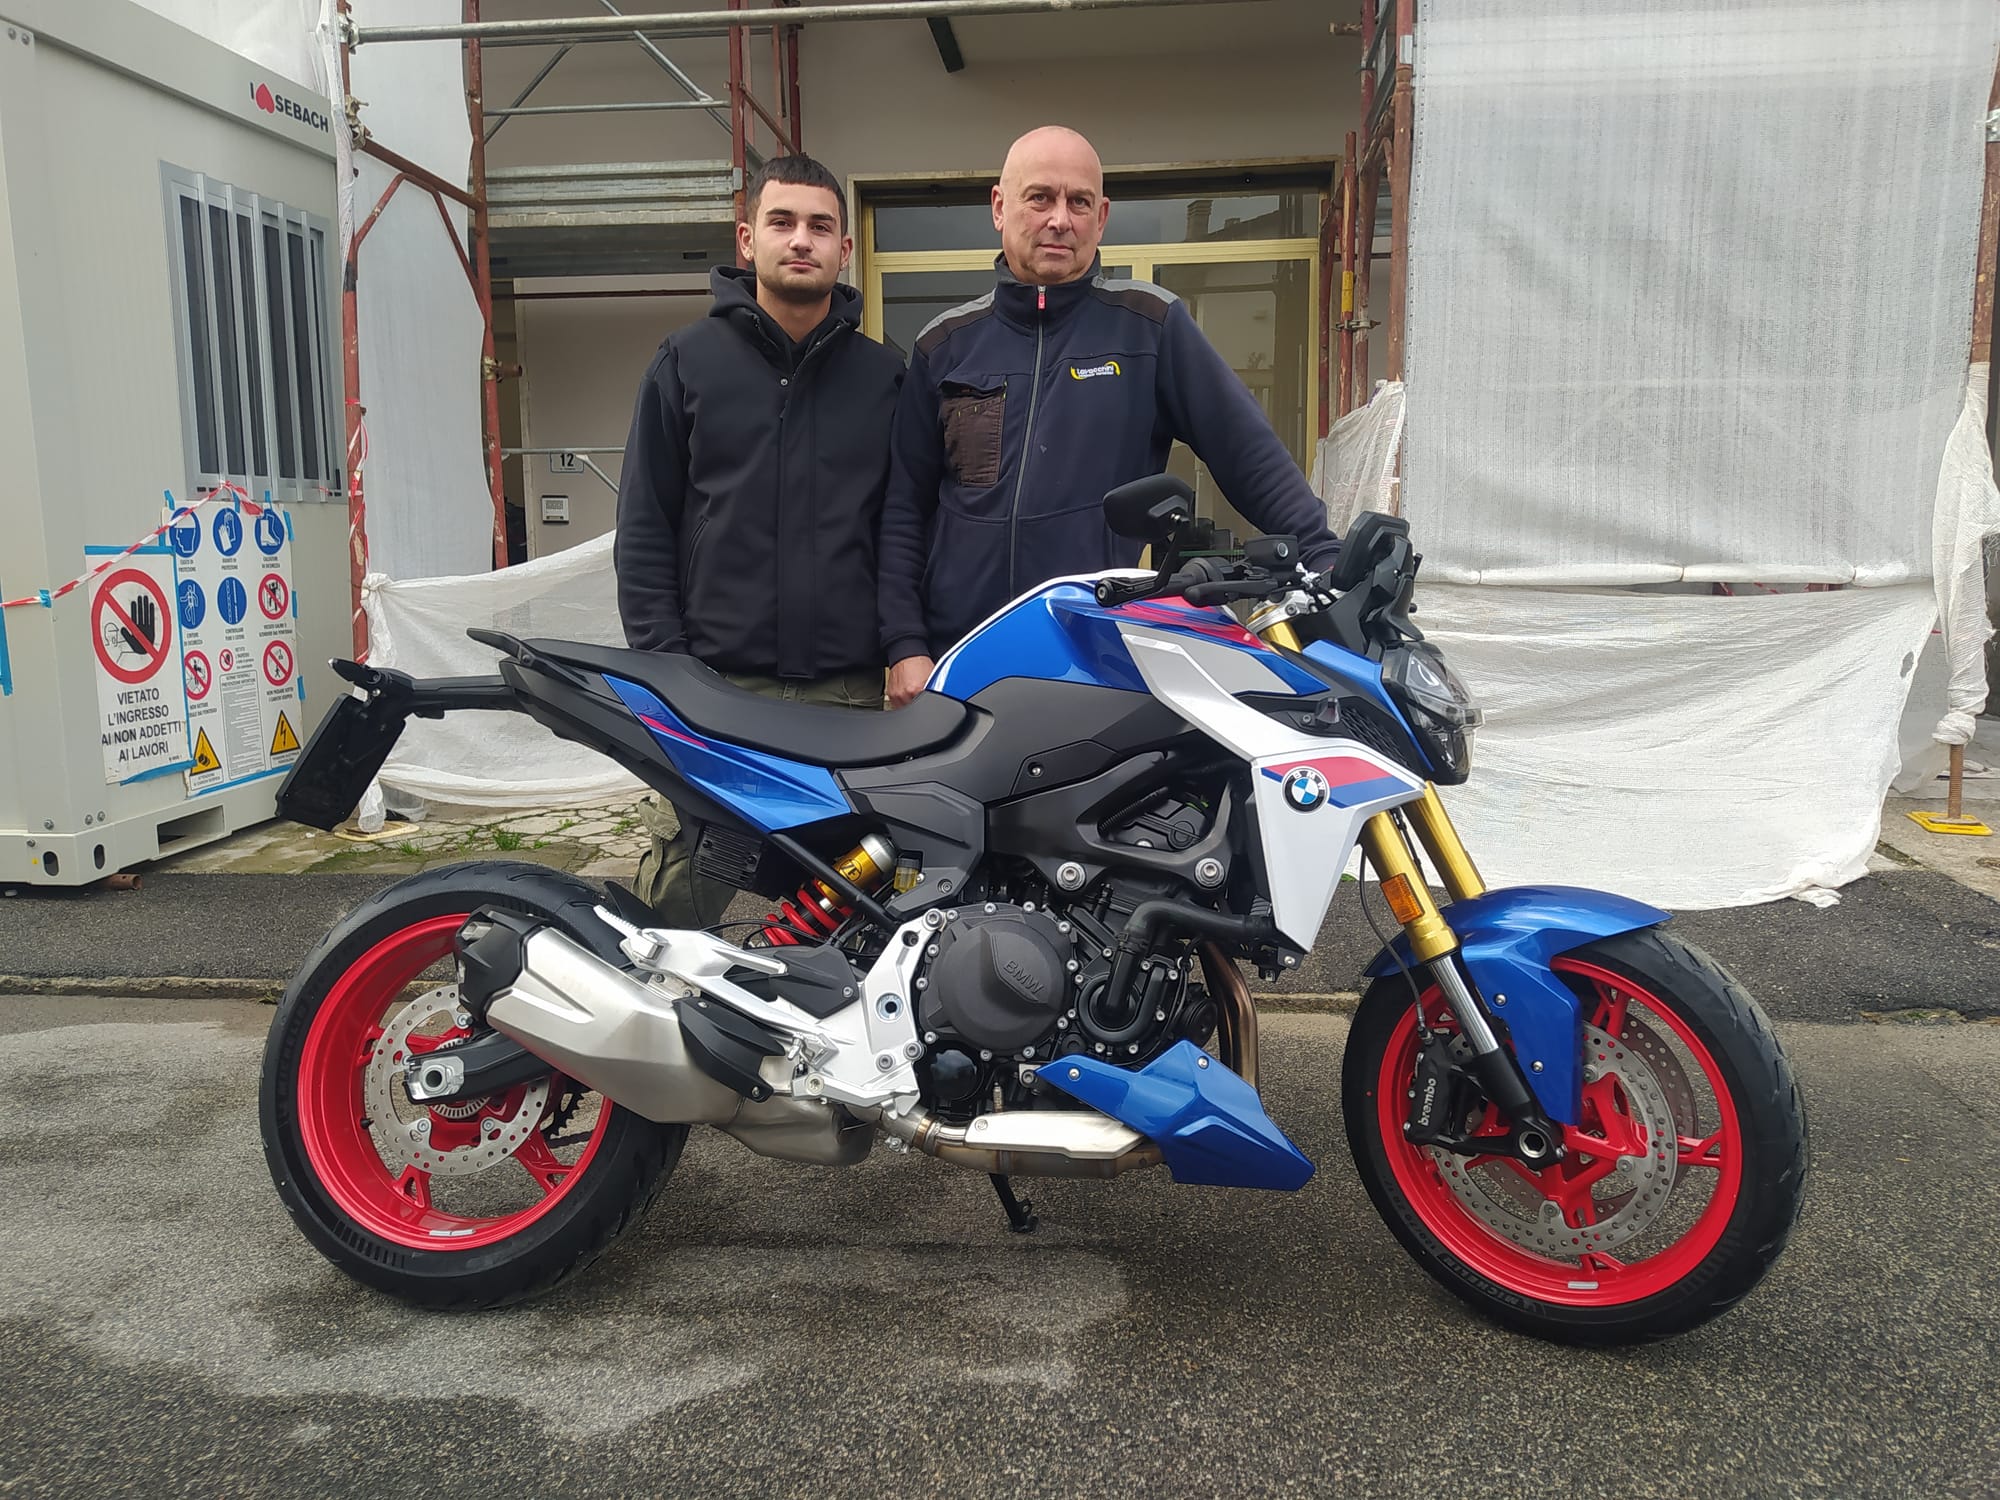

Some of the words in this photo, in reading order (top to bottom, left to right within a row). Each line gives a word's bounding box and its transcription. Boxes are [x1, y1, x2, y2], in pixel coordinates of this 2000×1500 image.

[250, 82, 254, 100] I
[275, 94, 329, 133] SEBACH
[560, 453, 574, 467] 12
[117, 688, 160, 705] VIETATO
[108, 704, 169, 726] L'INGRESSO
[101, 732, 112, 746] AI
[114, 728, 137, 744] NON
[140, 720, 182, 740] ADDETTI
[119, 748, 129, 762] AI
[132, 740, 169, 760] LAVORI
[1003, 960, 1045, 994] BMW
[1418, 1078, 1437, 1127] brembo
[1442, 1256, 1520, 1305] MICHELIN
